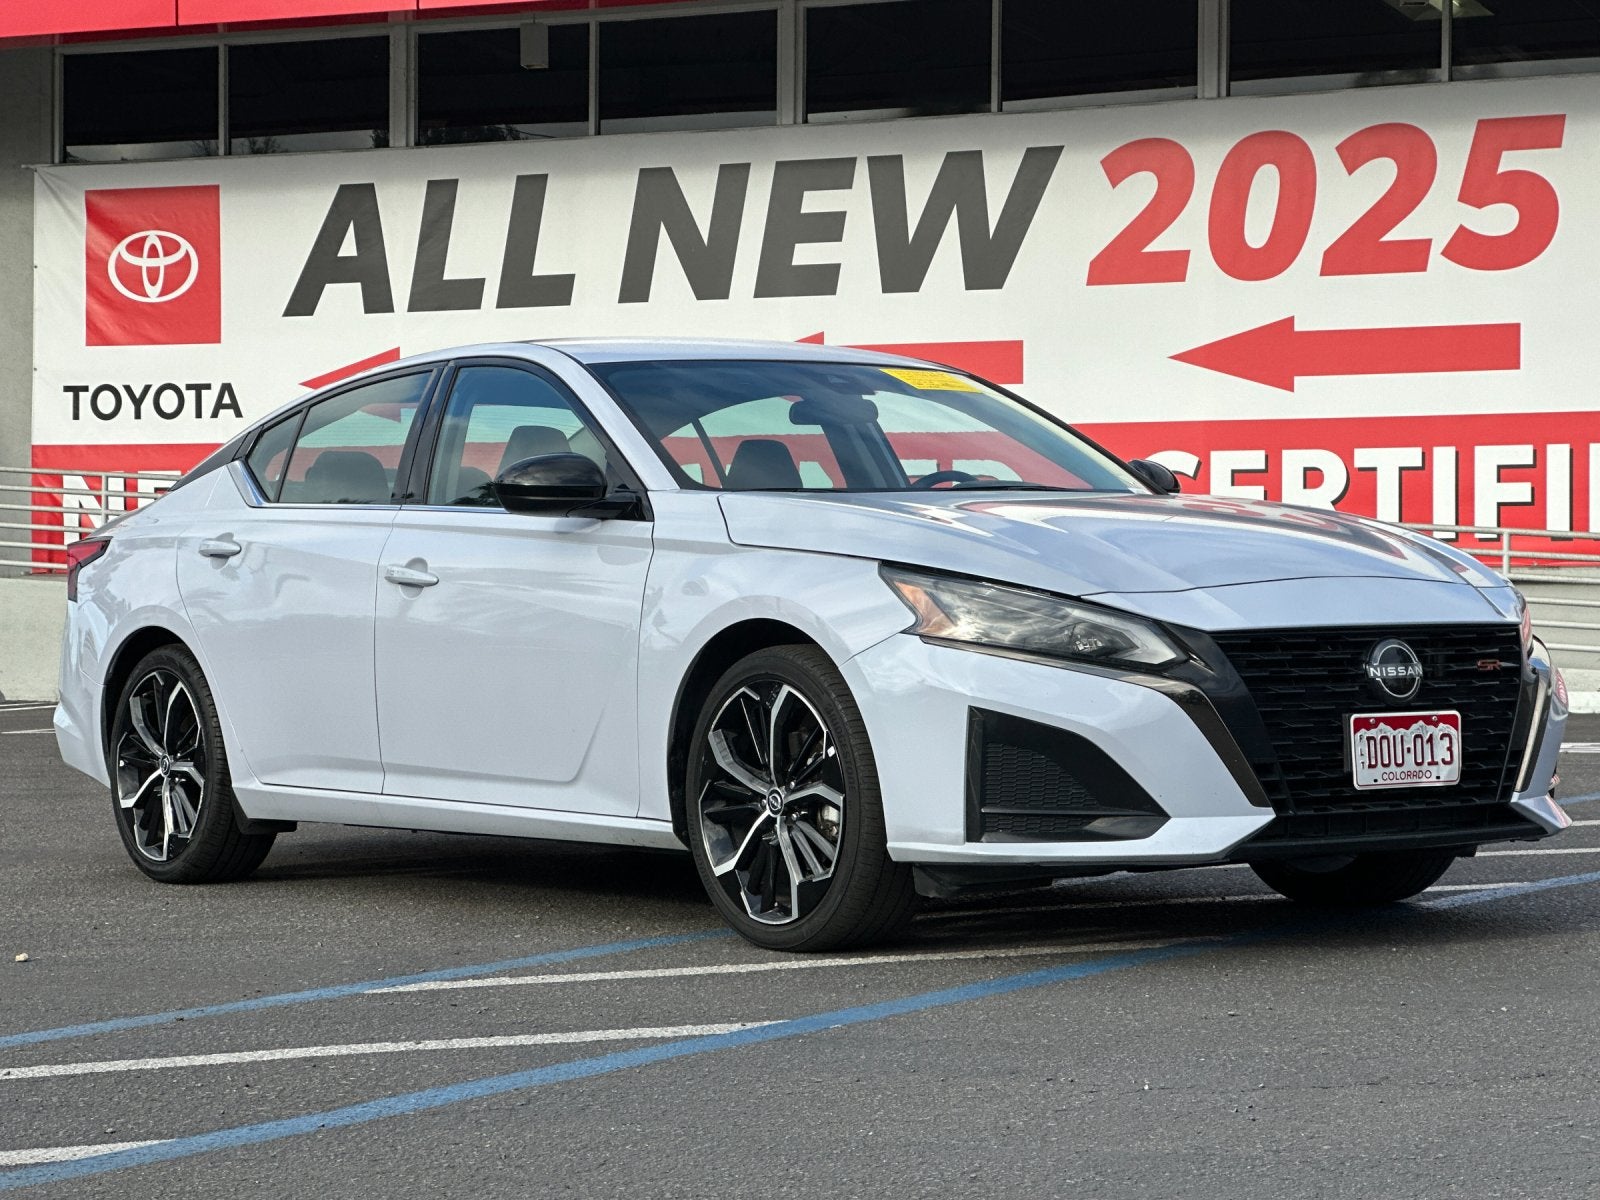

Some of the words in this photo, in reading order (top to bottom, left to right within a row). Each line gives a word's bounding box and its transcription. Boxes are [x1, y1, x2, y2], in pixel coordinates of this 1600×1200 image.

[283, 172, 576, 317] ALL
[618, 144, 1065, 304] NEW
[1086, 114, 1566, 286] 2025
[63, 382, 243, 420] TOYOTA
[1145, 443, 1600, 542] ERTIFI
[1369, 664, 1423, 678] NISSAN
[1476, 659, 1501, 671] SR
[1381, 769, 1433, 782] COLORADO
